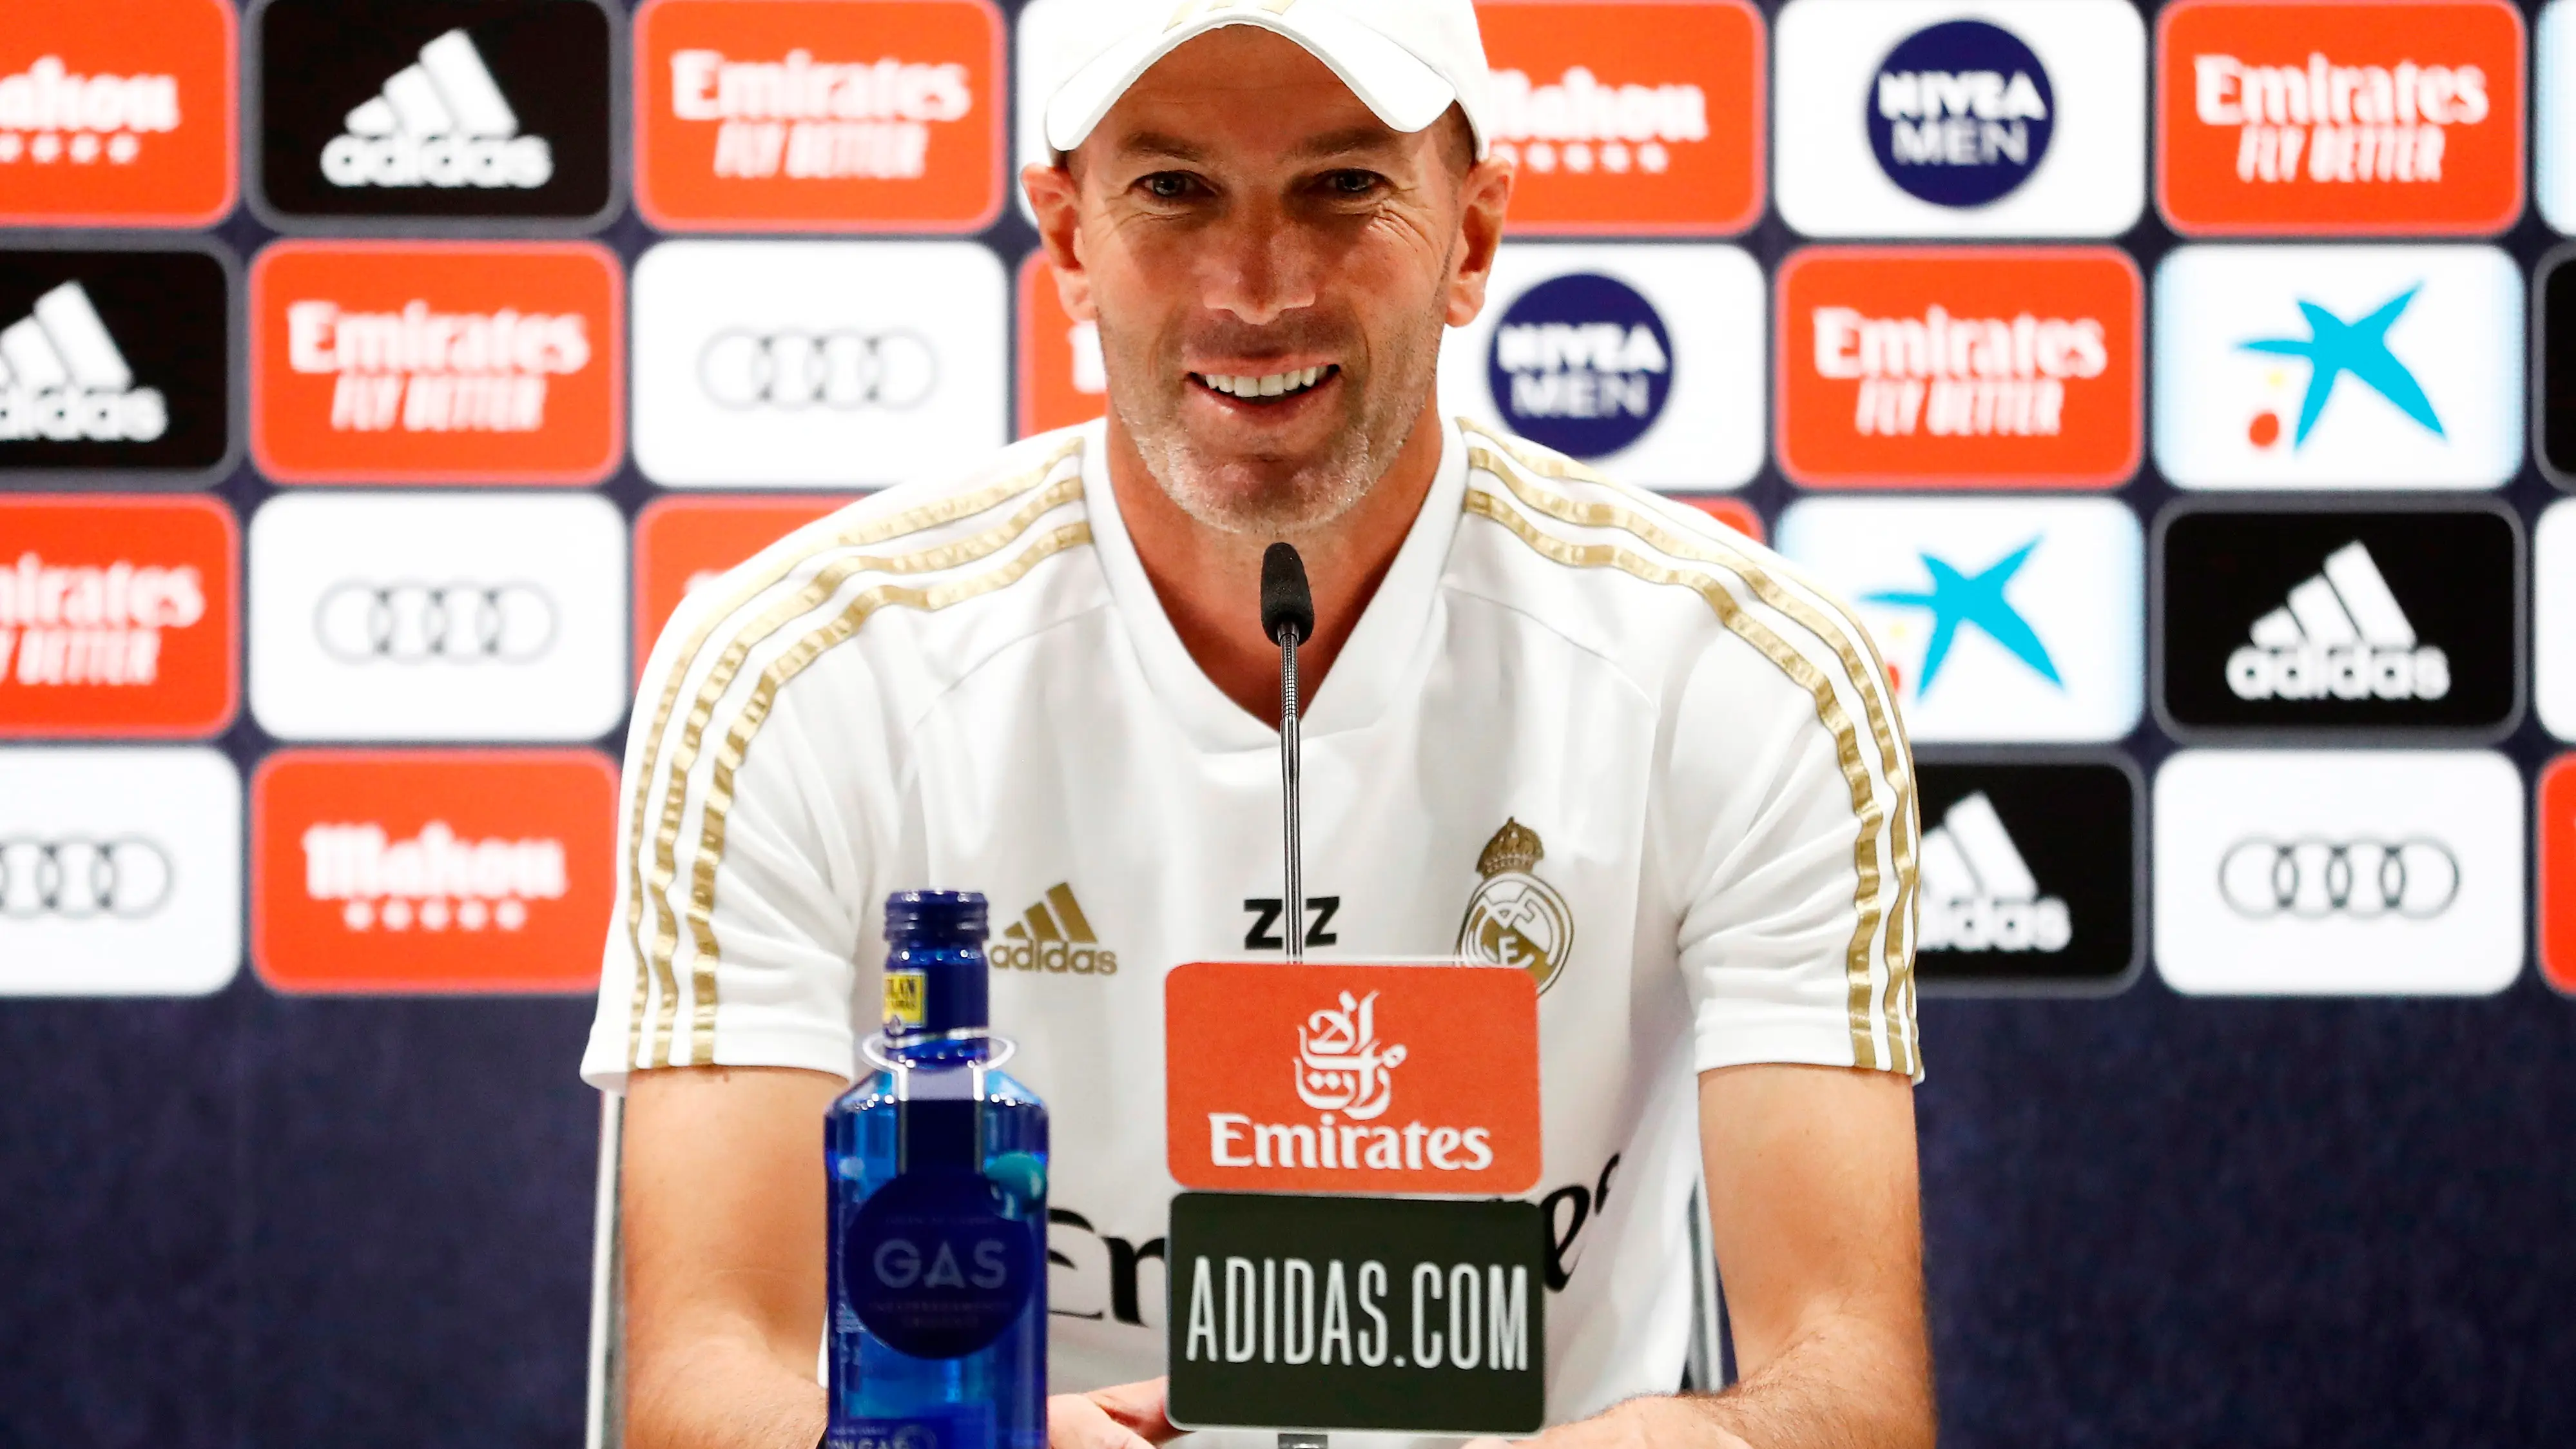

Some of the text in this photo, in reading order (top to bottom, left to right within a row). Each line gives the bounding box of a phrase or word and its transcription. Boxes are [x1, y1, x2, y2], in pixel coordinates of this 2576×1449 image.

[0, 54, 182, 133] ahou
[670, 48, 972, 122] Emirates
[1878, 70, 2048, 121] NIVEA
[2194, 53, 2489, 126] Emirates
[320, 134, 554, 188] adidas
[1892, 119, 2028, 165] MEN
[287, 299, 591, 374] Emirates
[1497, 322, 1669, 373] NIVEA
[1813, 304, 2107, 379] Emirates
[0, 387, 169, 442] didas
[1511, 372, 1649, 418] MEN
[0, 552, 207, 628] irates
[2225, 647, 2450, 700] adidas
[302, 821, 569, 900] Mahou
[990, 938, 1118, 977] adidas
[1208, 1113, 1493, 1171] Emirates
[873, 1238, 1008, 1289] GAS
[1186, 1256, 1529, 1371] ADIDAS.COM
